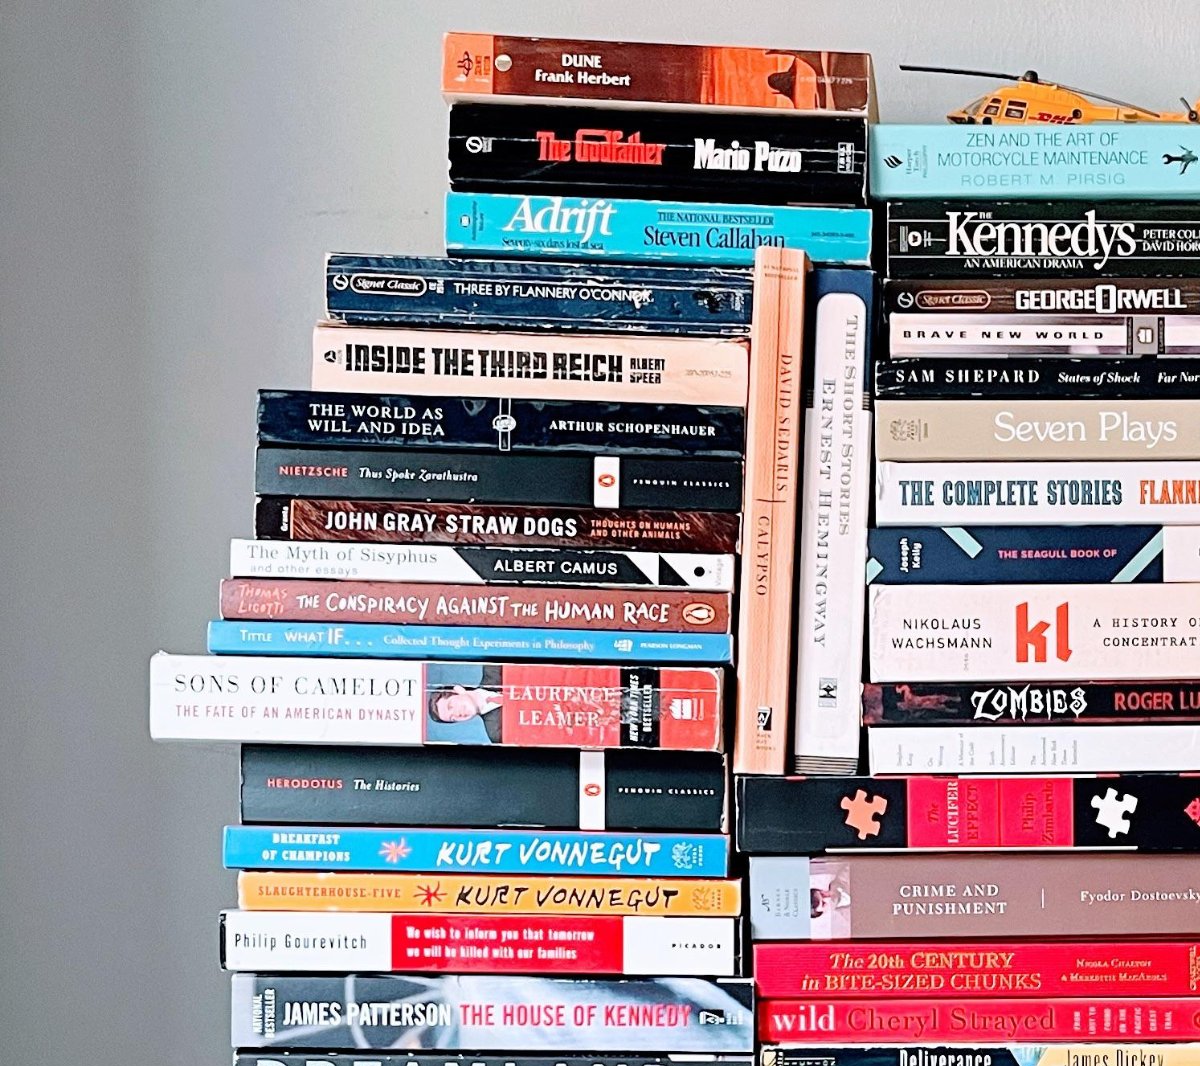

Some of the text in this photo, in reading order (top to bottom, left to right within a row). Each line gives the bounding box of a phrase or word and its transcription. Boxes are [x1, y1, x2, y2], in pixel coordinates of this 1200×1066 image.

[562, 54, 602, 69] DUNE
[535, 70, 631, 86] Frank Herbert
[537, 129, 666, 165] The Godfather
[966, 133, 1119, 147] ZEN AND THE ART OF
[938, 151, 1148, 166] MOTORCYCLE MAINTENANCE
[962, 173, 1033, 186] ROBERT
[1067, 172, 1125, 185] PIRSIG
[503, 197, 616, 236] Adrift
[643, 227, 700, 247] Steven
[705, 227, 785, 249] Callahan
[945, 210, 1136, 269] Kennedys
[964, 259, 1083, 269] AN AMERICAN DRAMA
[310, 404, 443, 420] THE WORLD AS
[308, 420, 444, 436] WILL AND IDEA
[550, 420, 715, 437] ARTHUR SCHOPENHAUER
[994, 412, 1087, 442] Seven
[1099, 412, 1177, 448] Plays
[279, 466, 478, 483] NIETZSCHE Thus Spoke Zarathustra
[899, 481, 935, 506] THE
[943, 480, 1038, 506] COMPLETE
[1047, 480, 1122, 505] STORIES
[325, 512, 577, 537] JOHN GRAY STRAW DOGS
[494, 559, 618, 575] ALBERT CAMUS
[175, 675, 418, 697] SONS OF CAMELOT
[176, 704, 416, 722] THE FATE OF AN AMERICAN DYNASTY
[268, 778, 420, 792] HERODOTUS The Histories
[258, 886, 401, 898] SLAUGHTERHOUSE-FIVE
[900, 884, 999, 897] CRIME AND
[1080, 889, 1126, 905] Fyodor
[893, 901, 1007, 915] PUNISHMENT
[235, 934, 367, 953] Philip Gourevitch
[459, 1005, 690, 1028] THE HOUSE OF KENNEDY
